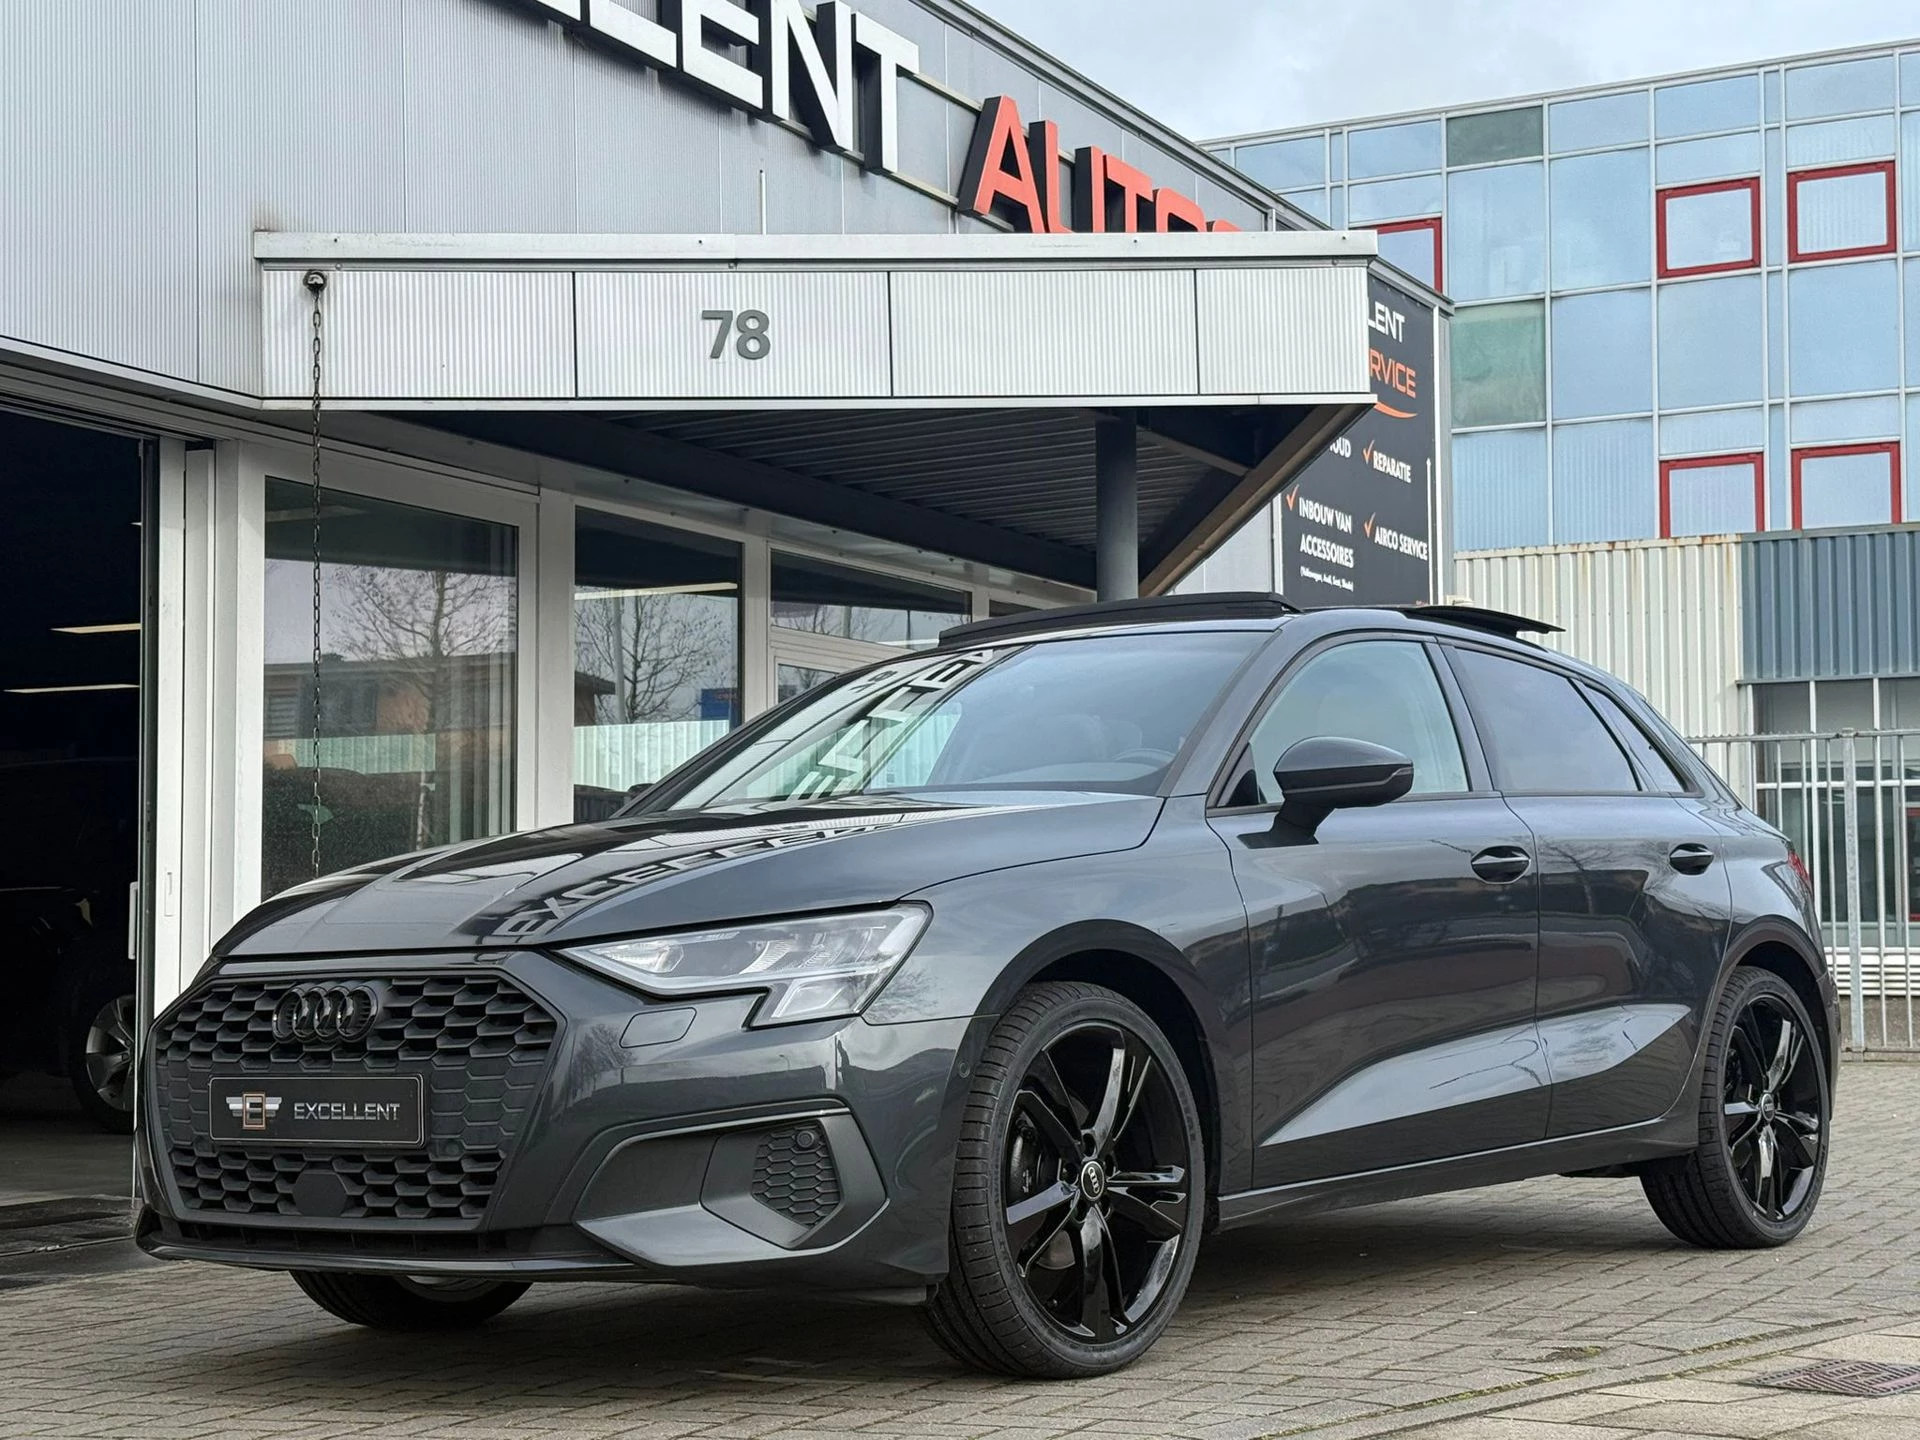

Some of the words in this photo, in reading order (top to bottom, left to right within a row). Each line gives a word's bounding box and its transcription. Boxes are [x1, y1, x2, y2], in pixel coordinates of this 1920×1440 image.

[537, 0, 919, 173] LENT
[970, 95, 1243, 233] AUT
[701, 309, 771, 360] 78
[1330, 437, 1352, 458] OUD
[1373, 451, 1412, 483] REPARATIE
[1299, 497, 1333, 527] INBOUW
[1335, 510, 1353, 534] VAN
[1300, 534, 1354, 568] ACCESSOIRES
[1375, 526, 1398, 550] AIRCO
[1399, 534, 1428, 561] SERVICE
[294, 1102, 401, 1120] EXCELLENT
